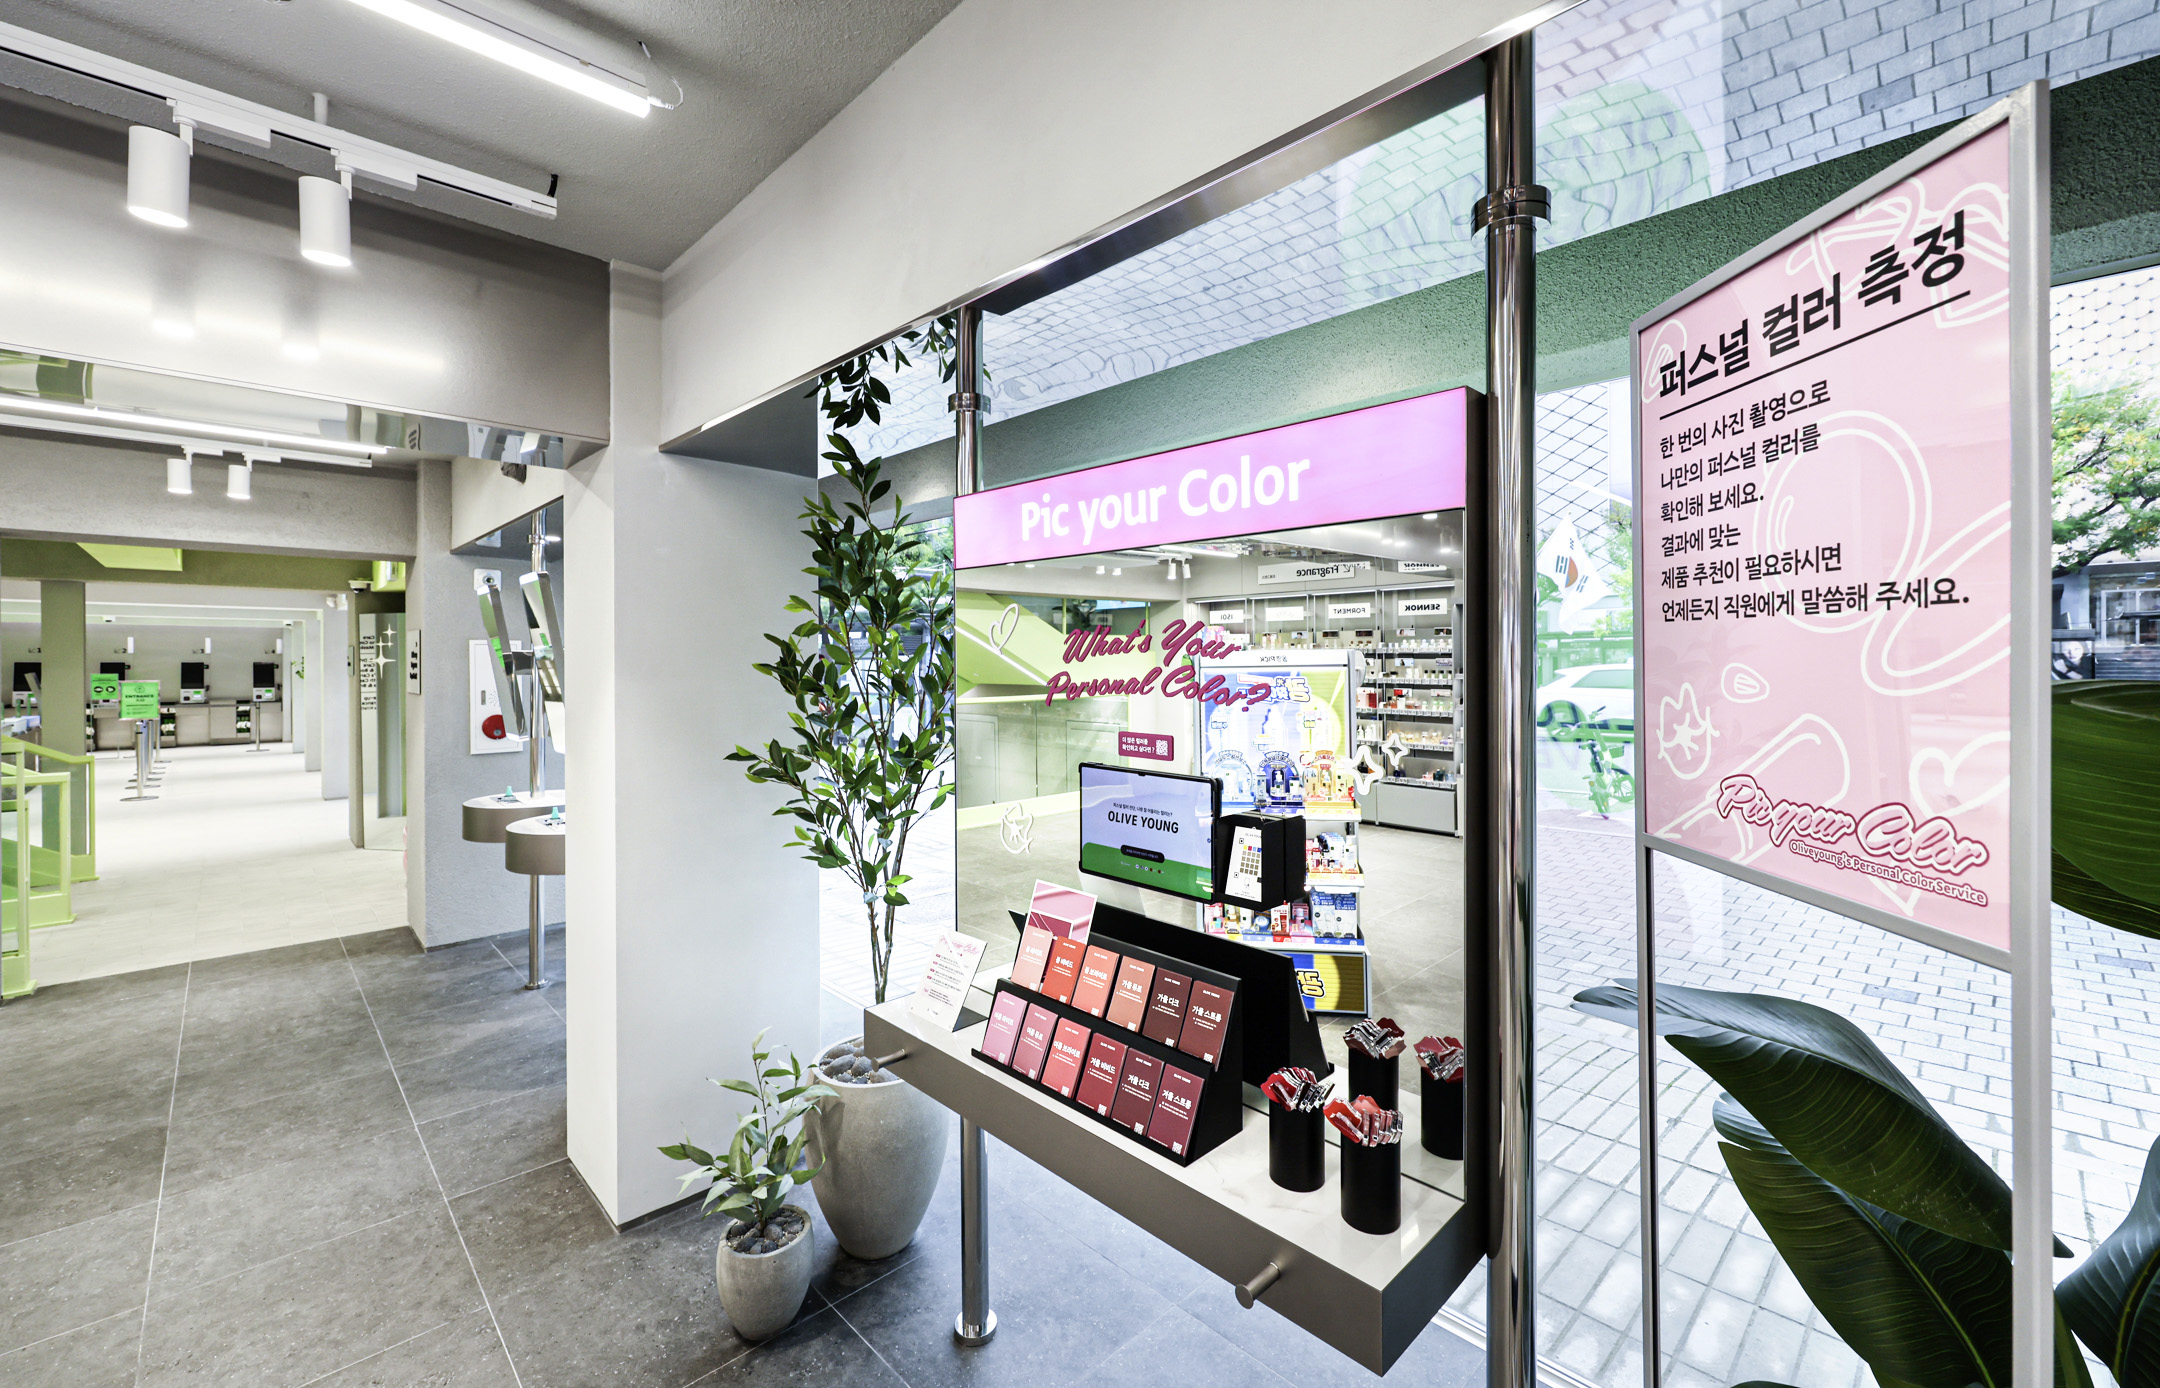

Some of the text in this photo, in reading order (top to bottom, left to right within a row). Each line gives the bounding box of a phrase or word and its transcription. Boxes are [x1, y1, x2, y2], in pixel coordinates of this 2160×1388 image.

[1660, 209, 1965, 398] 퍼스널 컬러 측정
[1660, 380, 1831, 459] 한 번의 사진 촬영으로
[1661, 423, 1821, 490] 나만의 퍼스널 컬러를
[1022, 455, 1310, 546] Pic your Color
[1660, 482, 1764, 523] 확인해 보세요.
[1661, 523, 1741, 557] 결과에 맞는
[1661, 542, 1842, 589] 제품 추천이 필요하시면
[1662, 576, 1969, 622] 언제든지 직원에게 말씀해 주세요.
[1063, 619, 1243, 667] What's Your
[1045, 667, 1162, 707] Personal
[1161, 665, 1271, 712] Color?
[1108, 810, 1179, 834] OLIVE YOUNG
[1718, 775, 1989, 875] Pic your Color
[1790, 841, 1986, 904] Oliveyoung's Personal Color Service
